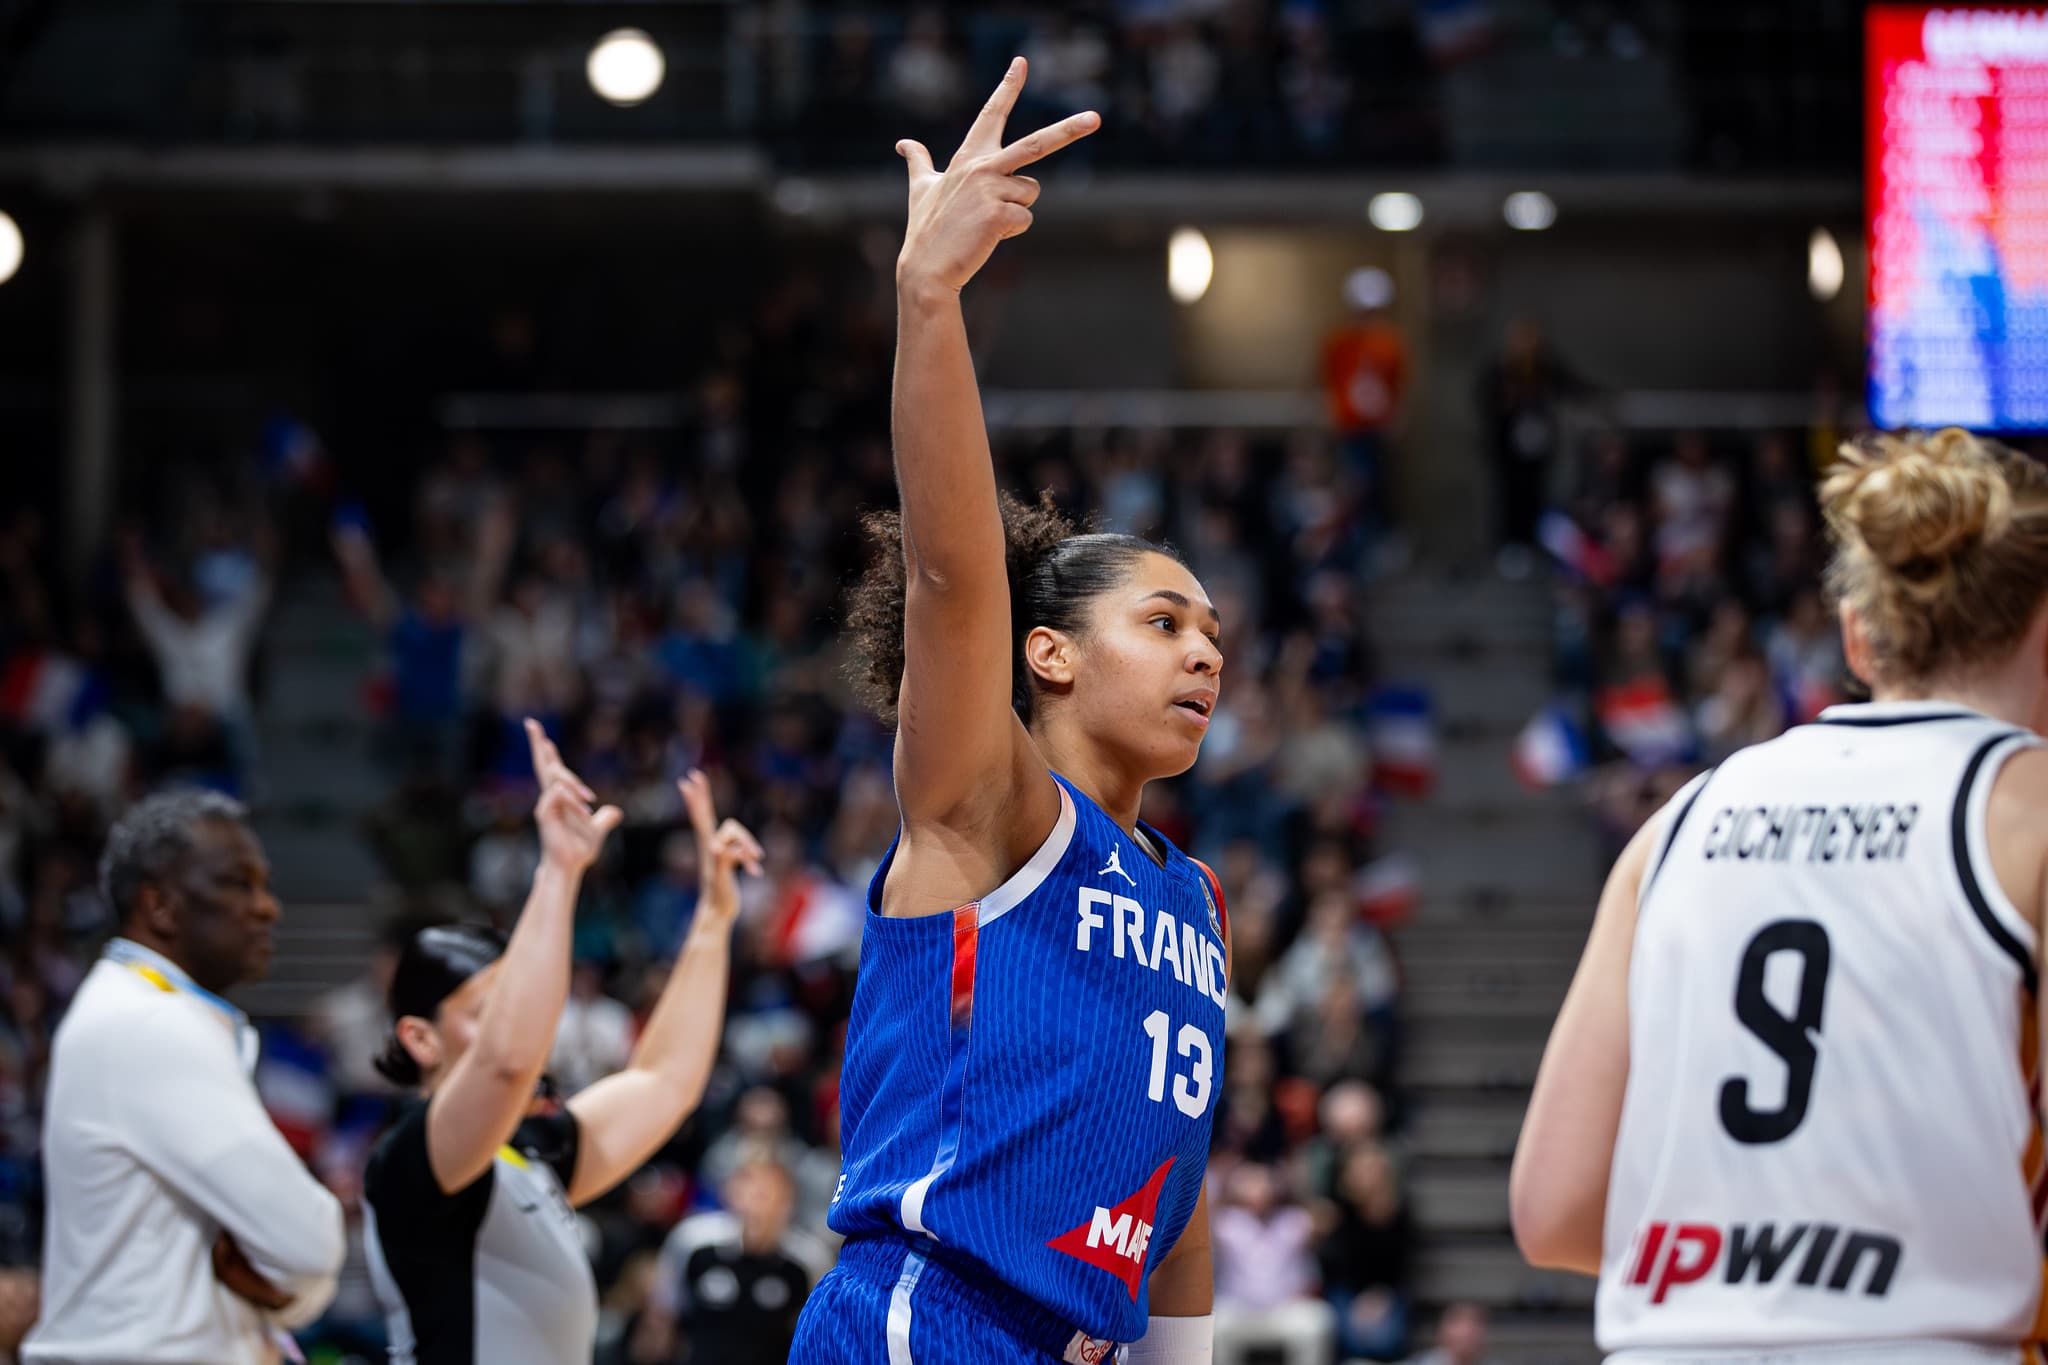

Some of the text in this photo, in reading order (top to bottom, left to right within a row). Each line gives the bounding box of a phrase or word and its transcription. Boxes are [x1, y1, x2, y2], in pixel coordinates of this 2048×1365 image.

[1704, 804, 1919, 862] EICHMEYER
[1077, 886, 1227, 1010] FRANC
[1143, 1009, 1213, 1119] 13
[1718, 917, 1831, 1145] 9
